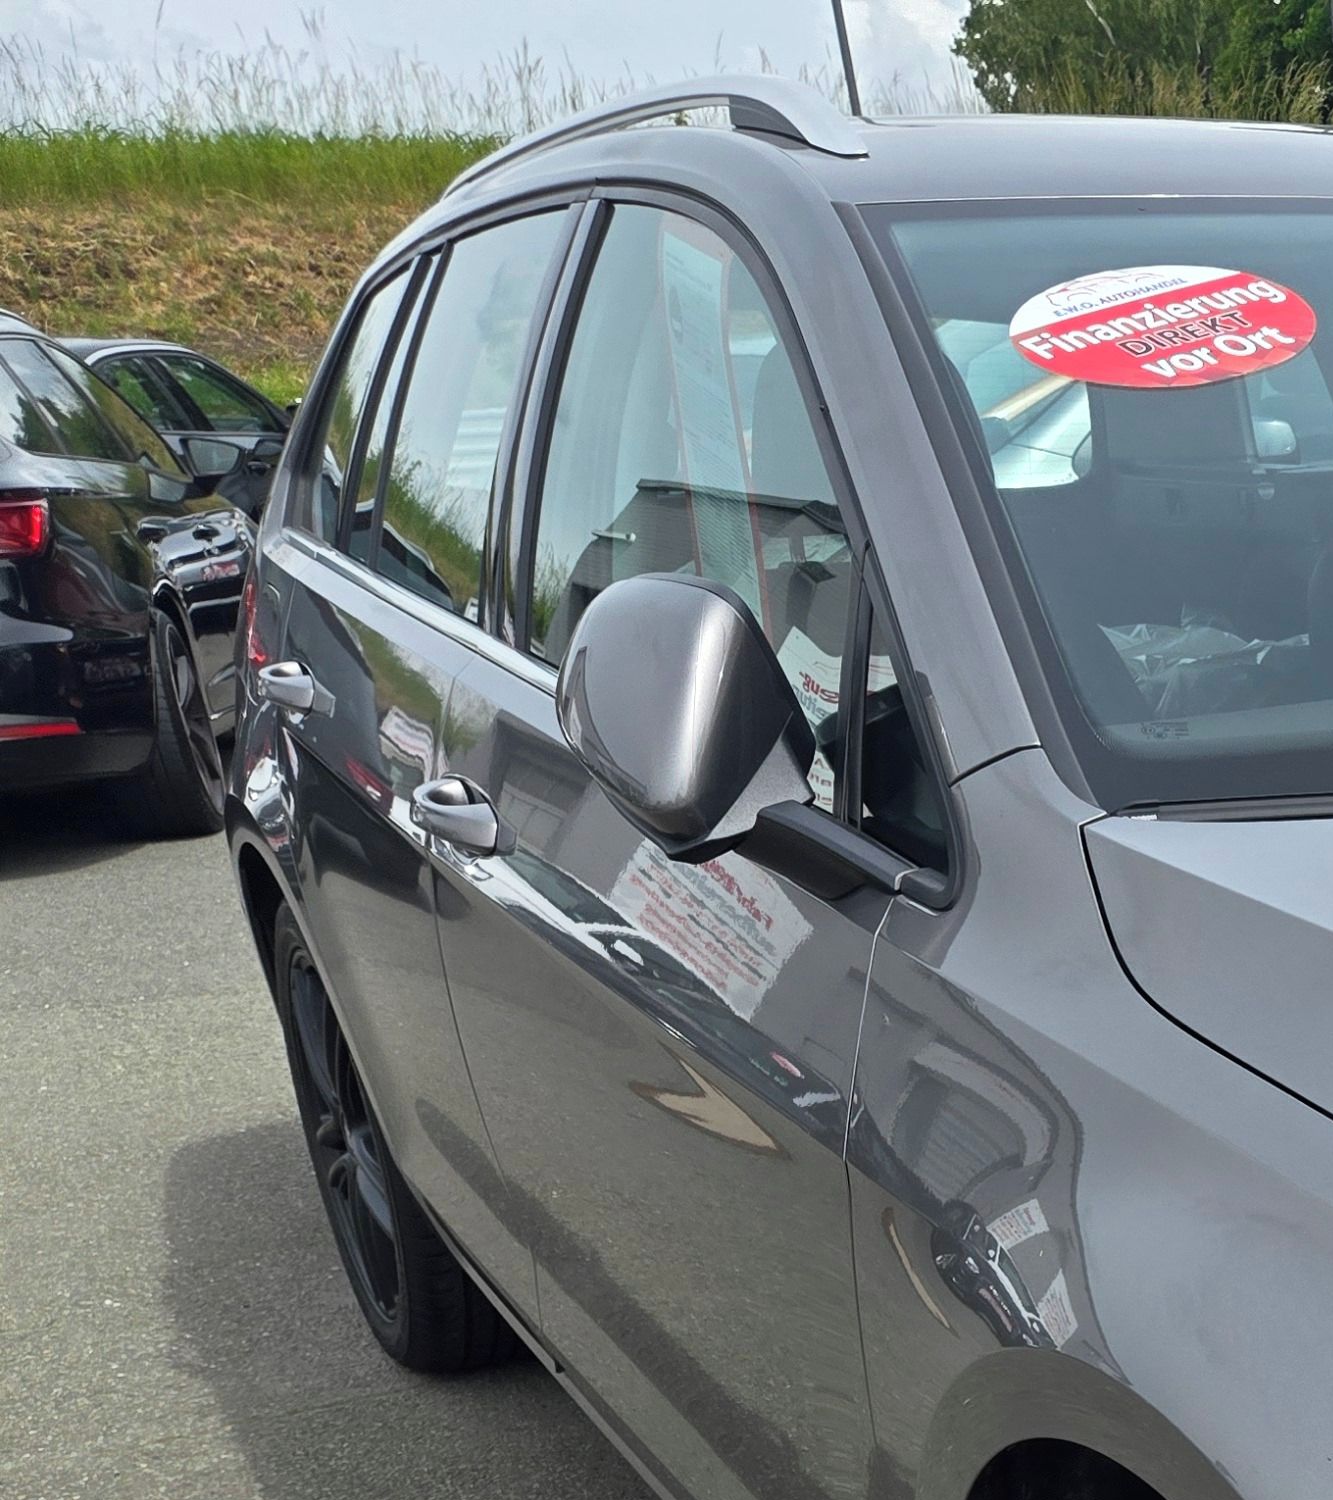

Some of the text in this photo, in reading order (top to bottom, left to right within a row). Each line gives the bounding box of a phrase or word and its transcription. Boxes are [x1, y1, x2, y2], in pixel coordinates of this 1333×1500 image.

[1099, 277, 1187, 306] AUTOHANDEL
[1018, 279, 1287, 361] Finanzierung
[1117, 310, 1253, 357] DIREKT
[1142, 324, 1295, 379] vor Ort
